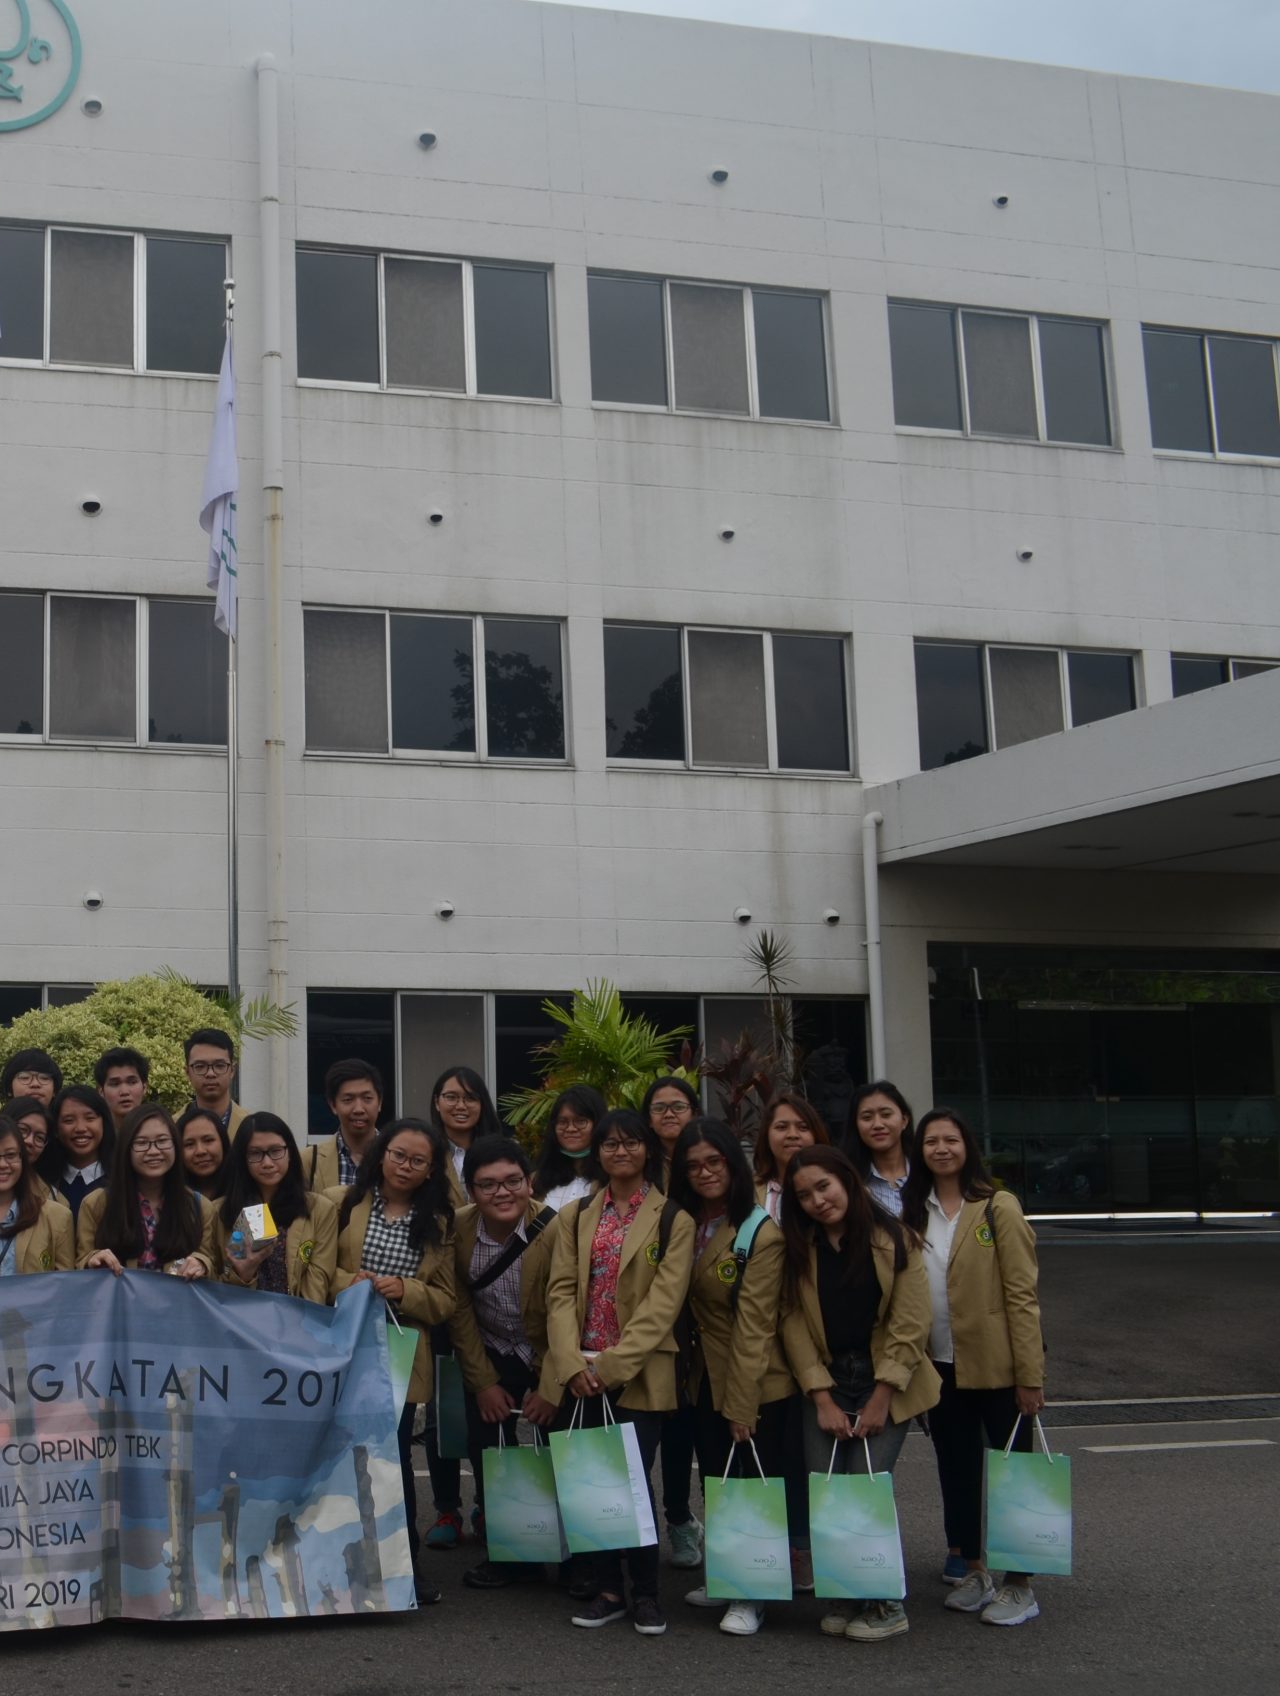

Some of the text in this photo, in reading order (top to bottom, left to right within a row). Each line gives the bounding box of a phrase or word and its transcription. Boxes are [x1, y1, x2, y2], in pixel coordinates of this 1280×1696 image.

[261, 1367, 345, 1408] 201
[1, 1435, 118, 1467] CORPINDO
[124, 1433, 162, 1460] TBK
[37, 1478, 96, 1506] JAYA
[23, 1577, 82, 1609] 2019
